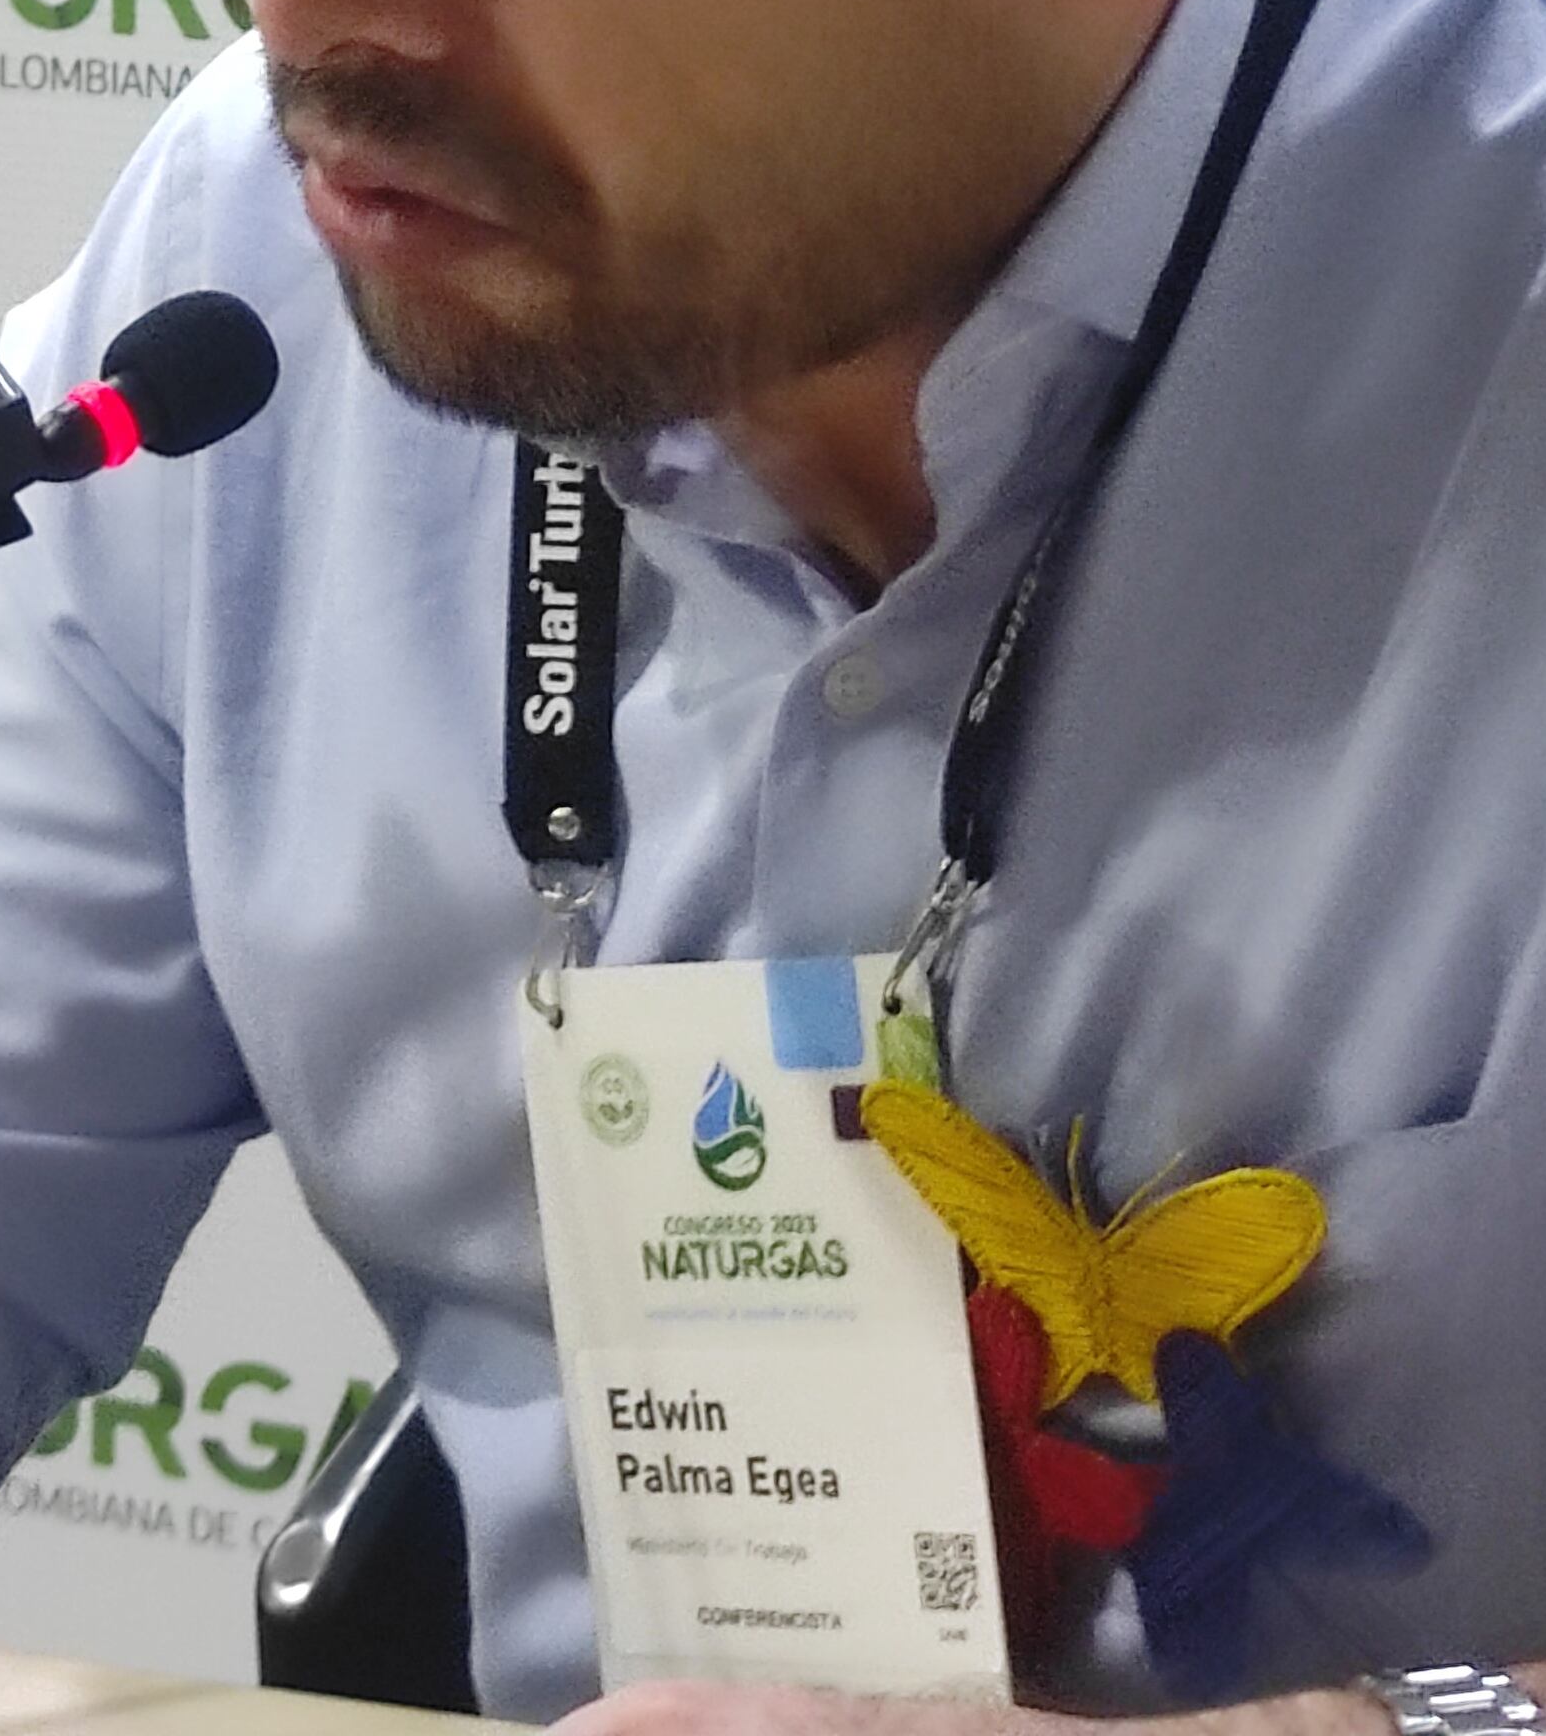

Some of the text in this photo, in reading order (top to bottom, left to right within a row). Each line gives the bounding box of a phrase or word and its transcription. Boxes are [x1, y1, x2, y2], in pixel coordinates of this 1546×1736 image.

[523, 453, 584, 736] Solar Turb
[641, 1239, 848, 1280] NATURGAS
[607, 1388, 728, 1432] Edwin
[616, 1453, 840, 1504] Palma Egea
